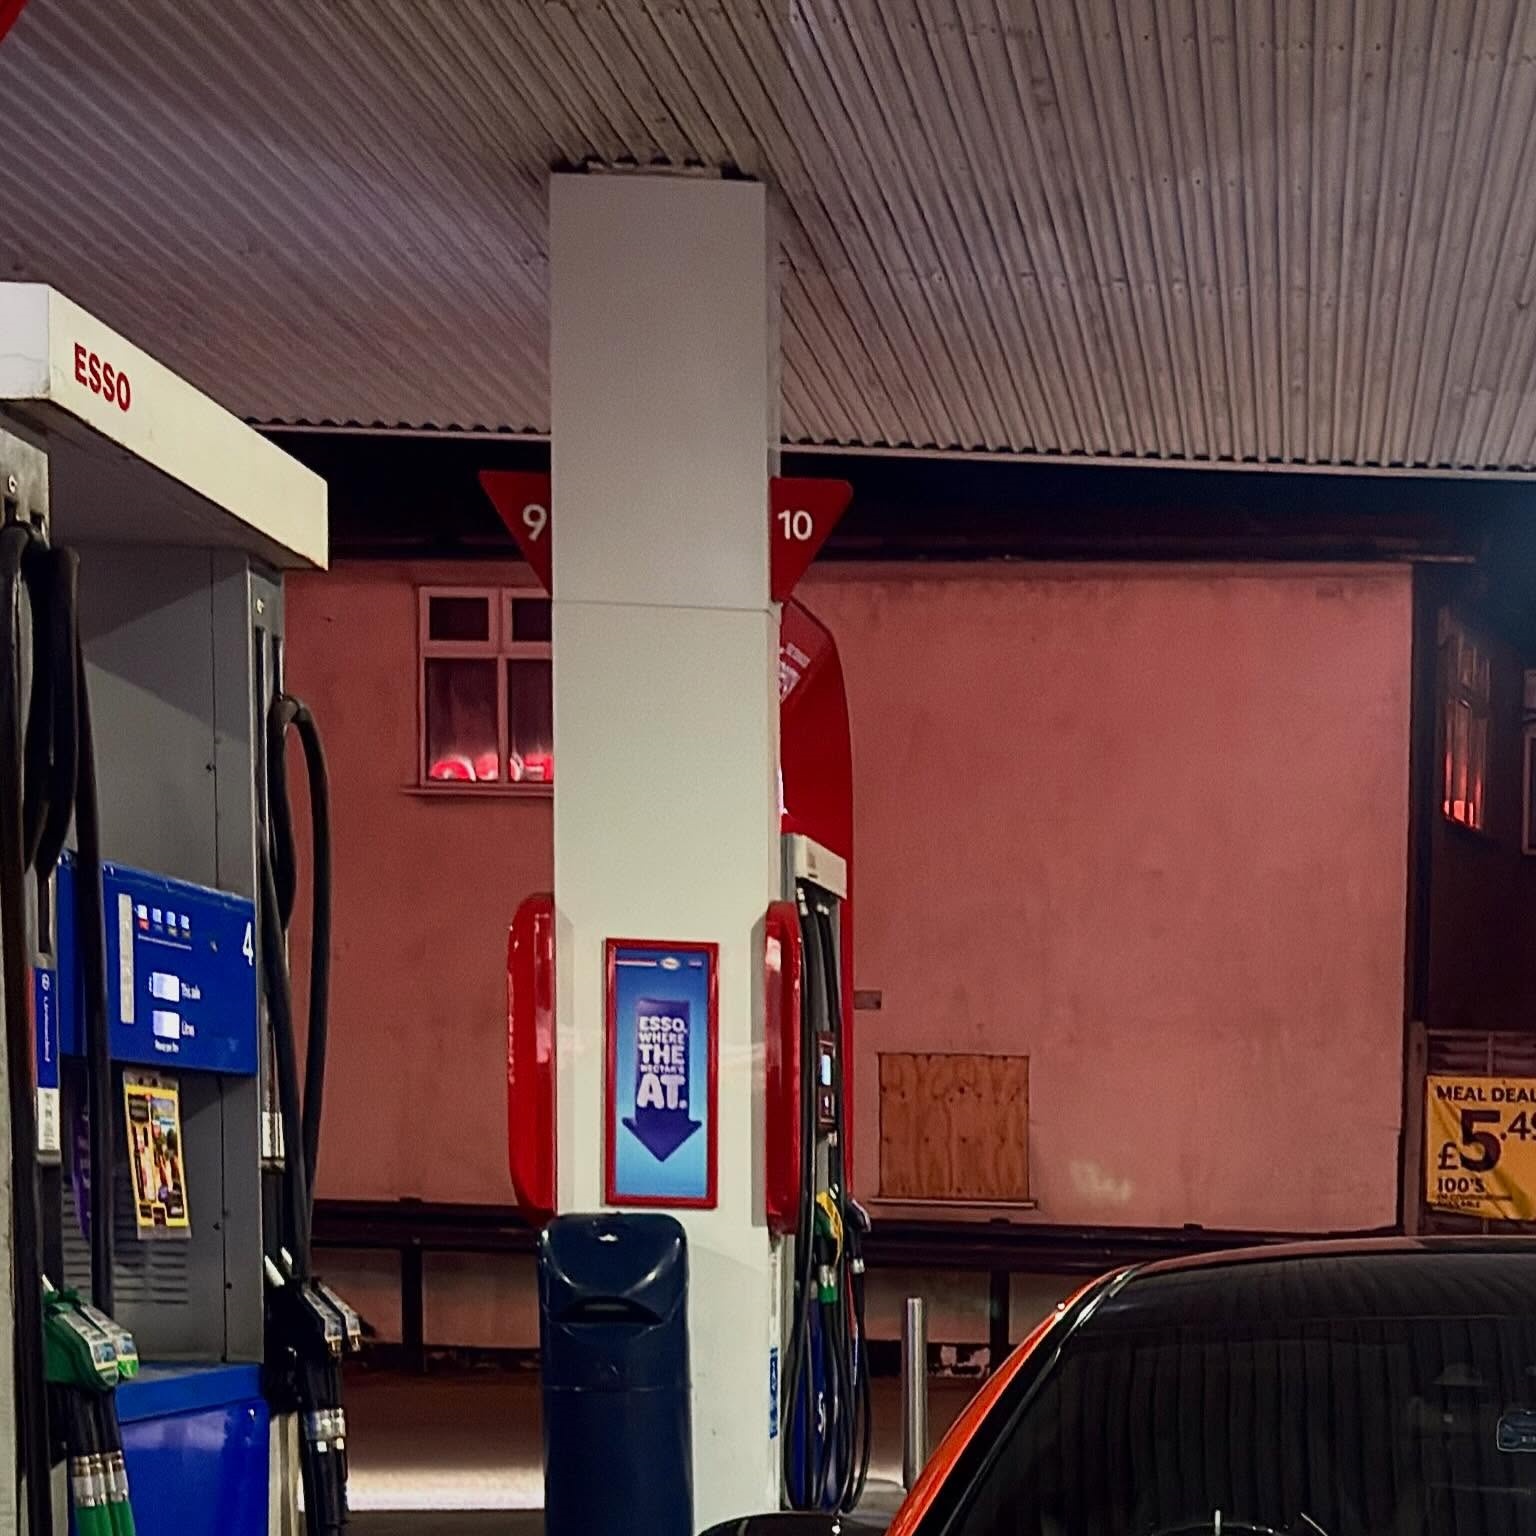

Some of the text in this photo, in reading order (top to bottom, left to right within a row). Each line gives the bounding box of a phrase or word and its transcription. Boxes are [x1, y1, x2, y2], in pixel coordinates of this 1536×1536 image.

[74, 342, 131, 412] ESSO
[522, 504, 547, 541] 9
[777, 510, 813, 541] 10
[242, 921, 254, 966] 4
[638, 1044, 685, 1065] THE
[639, 1031, 685, 1045] WHERE
[637, 1073, 688, 1110] AT.
[1437, 1085, 1488, 1101] MEAL
